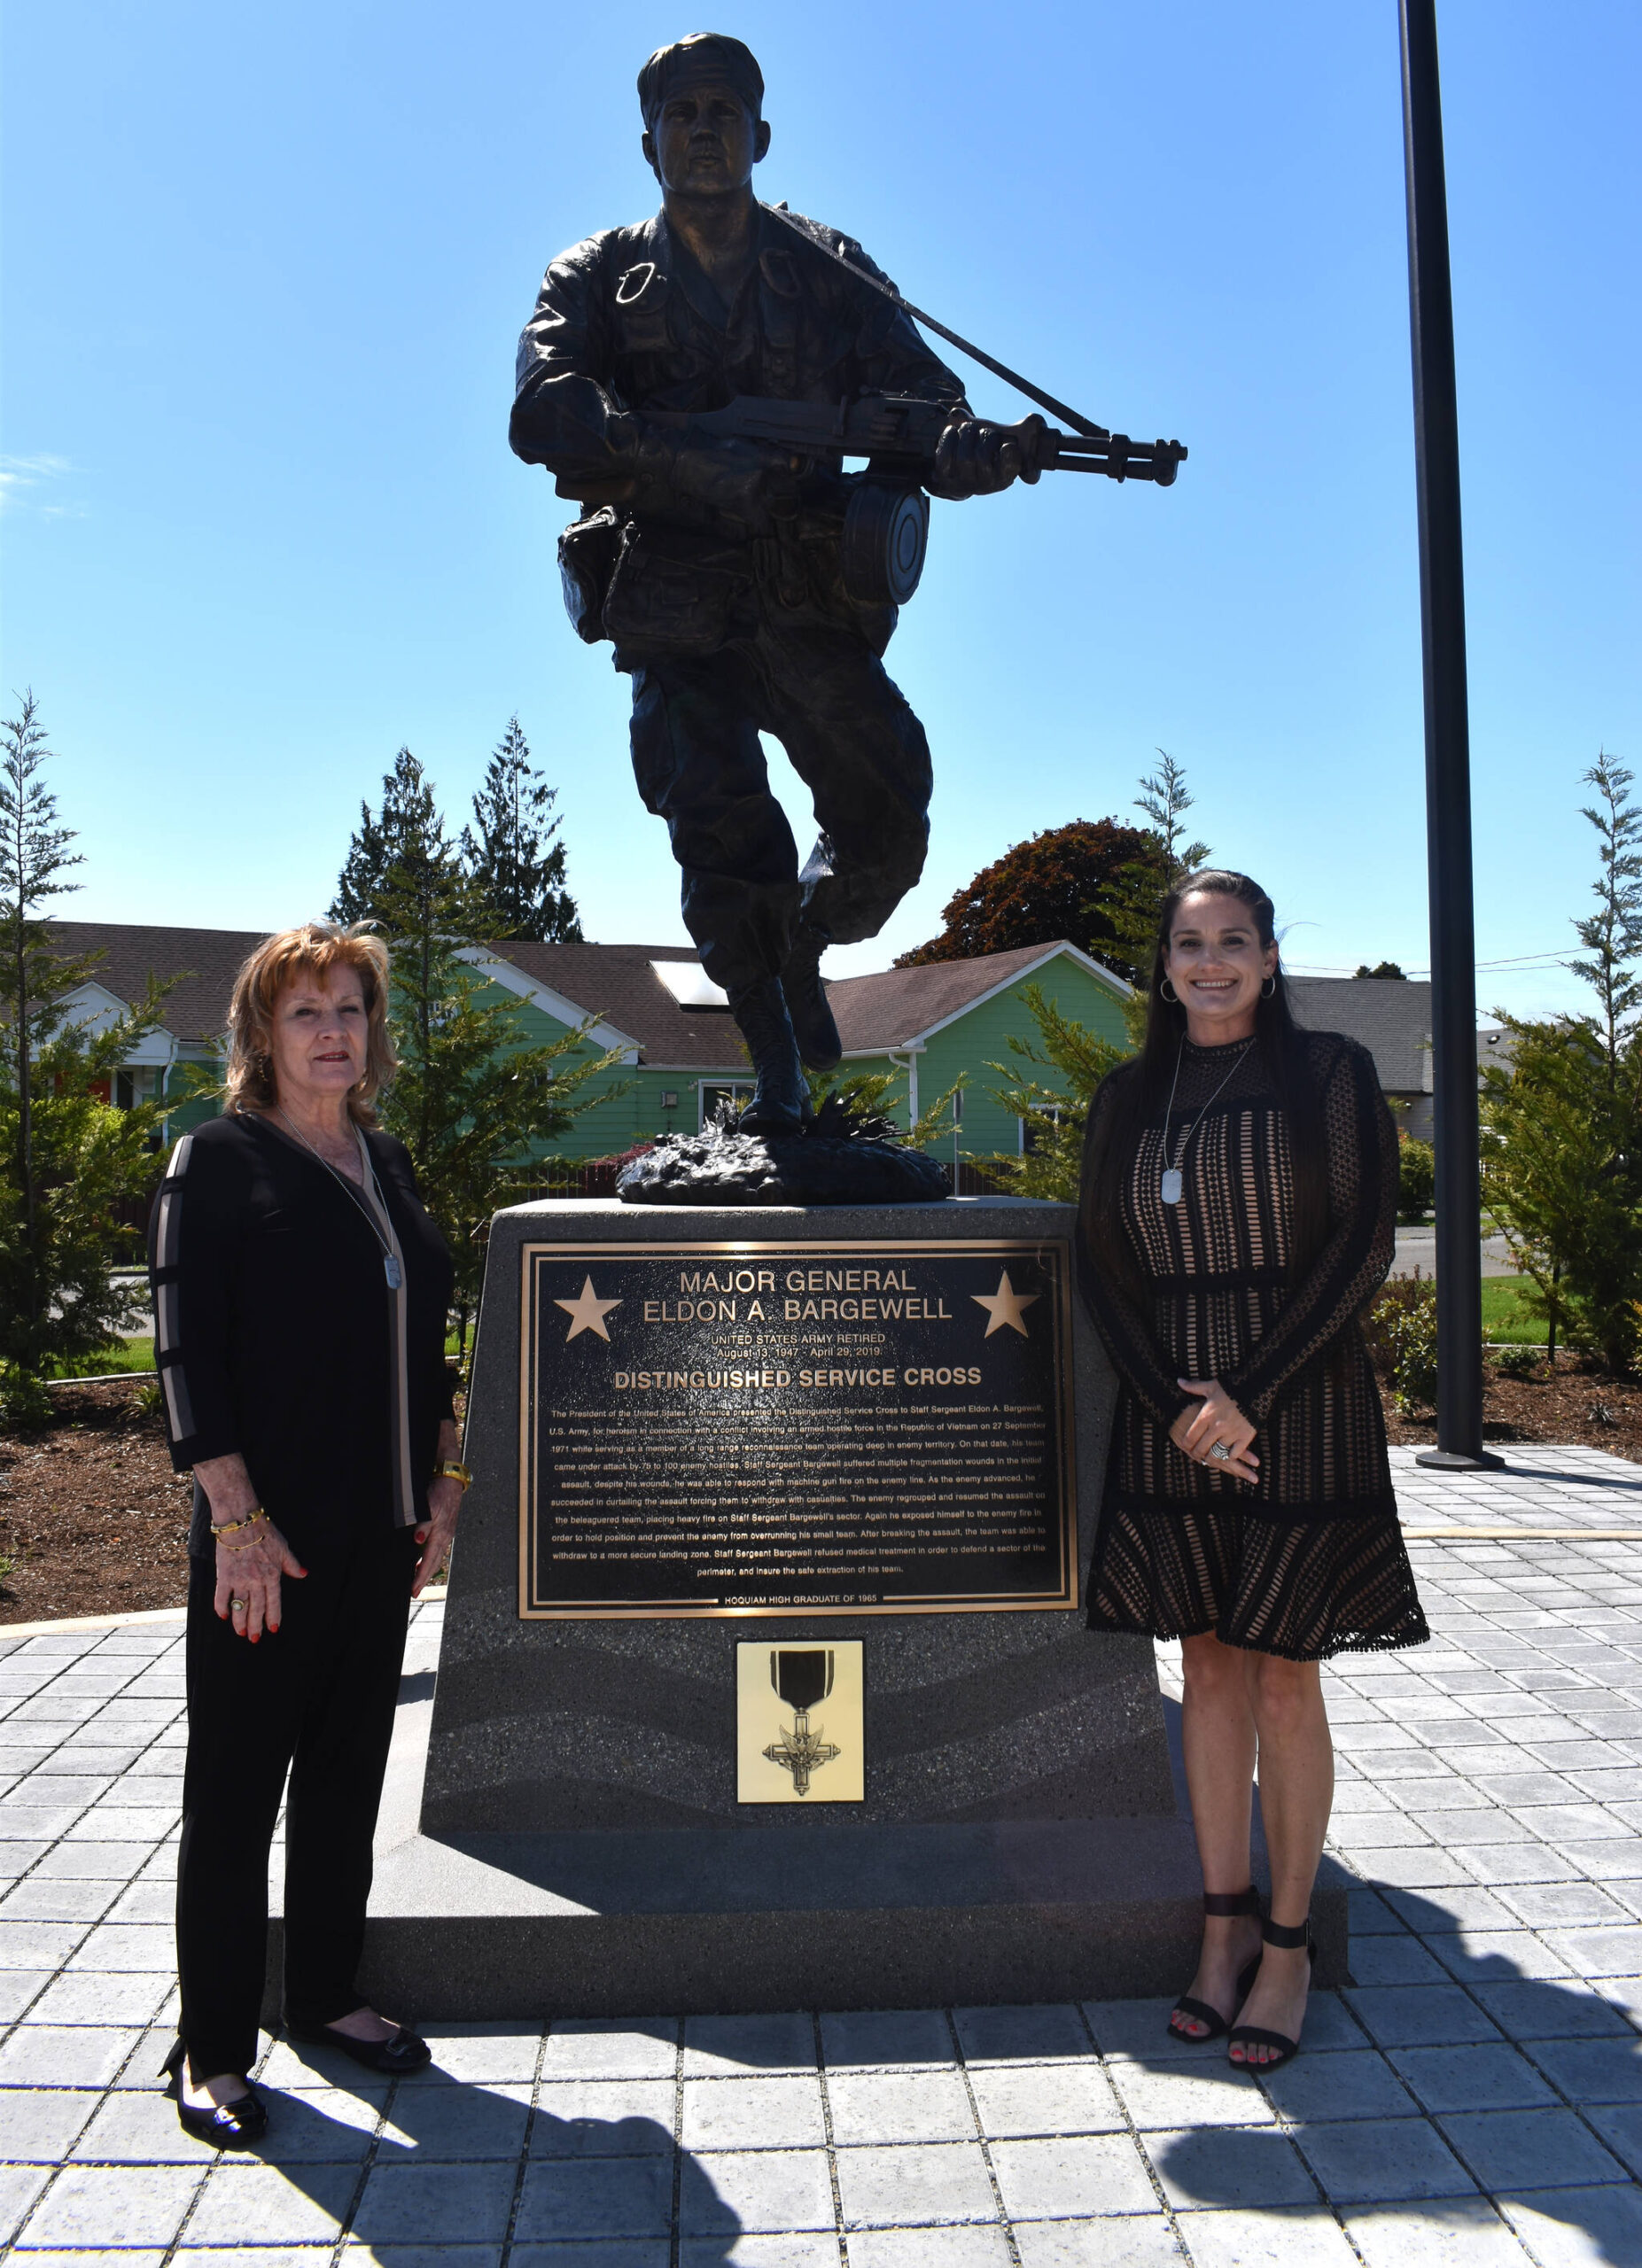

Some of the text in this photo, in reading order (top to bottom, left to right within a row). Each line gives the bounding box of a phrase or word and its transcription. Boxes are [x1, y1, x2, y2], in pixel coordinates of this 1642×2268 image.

[681, 1270, 915, 1293] MAJOR GENERAL
[643, 1299, 952, 1323] ELDON A. BARGEWELL
[712, 1333, 885, 1345] UNITED STATES ARMY RETIRED
[717, 1348, 751, 1359] August
[757, 1348, 769, 1358] 13,
[775, 1348, 798, 1357] 1947
[810, 1347, 835, 1357] April
[837, 1347, 852, 1357] 29,
[615, 1367, 982, 1389] DISTINGUISHED SERVICE CROSS
[733, 1408, 771, 1417] presented
[789, 1407, 841, 1416] Distinguished
[930, 1405, 966, 1415] Sergeant
[568, 1427, 590, 1436] Army,
[751, 1425, 784, 1434] involving
[900, 1424, 934, 1433] Republic
[594, 1445, 624, 1454] serving
[696, 1444, 714, 1453] long
[827, 1441, 863, 1451] operating
[865, 1441, 884, 1450] deep
[924, 1441, 955, 1449] territory.
[990, 1440, 1008, 1449] date,
[765, 1460, 800, 1470] Sergeant
[803, 1460, 841, 1469] Bargewell
[877, 1459, 907, 1468] multiple
[909, 1458, 962, 1467] fragmentation
[594, 1480, 623, 1489] despite
[734, 1479, 766, 1487] respond
[605, 1498, 642, 1507] curtailing
[689, 1496, 717, 1505] forcing
[896, 1494, 936, 1503] regrouped
[570, 1516, 619, 1525] beleaguered
[621, 1515, 643, 1524] team,
[645, 1515, 673, 1524] placing
[676, 1515, 700, 1524] heavy
[751, 1513, 787, 1522] Sergeant
[789, 1512, 834, 1522] Bargewell's
[865, 1511, 887, 1521] Again
[901, 1511, 934, 1520] exposed
[604, 1533, 635, 1542] position
[655, 1533, 684, 1542] prevent
[750, 1531, 797, 1540] overrunning
[881, 1529, 914, 1538] breaking
[932, 1528, 962, 1537] assault,
[658, 1550, 688, 1559] landing
[735, 1549, 771, 1558] Sergeant
[774, 1549, 812, 1557] Bargewell
[696, 1568, 736, 1577] perimeter,
